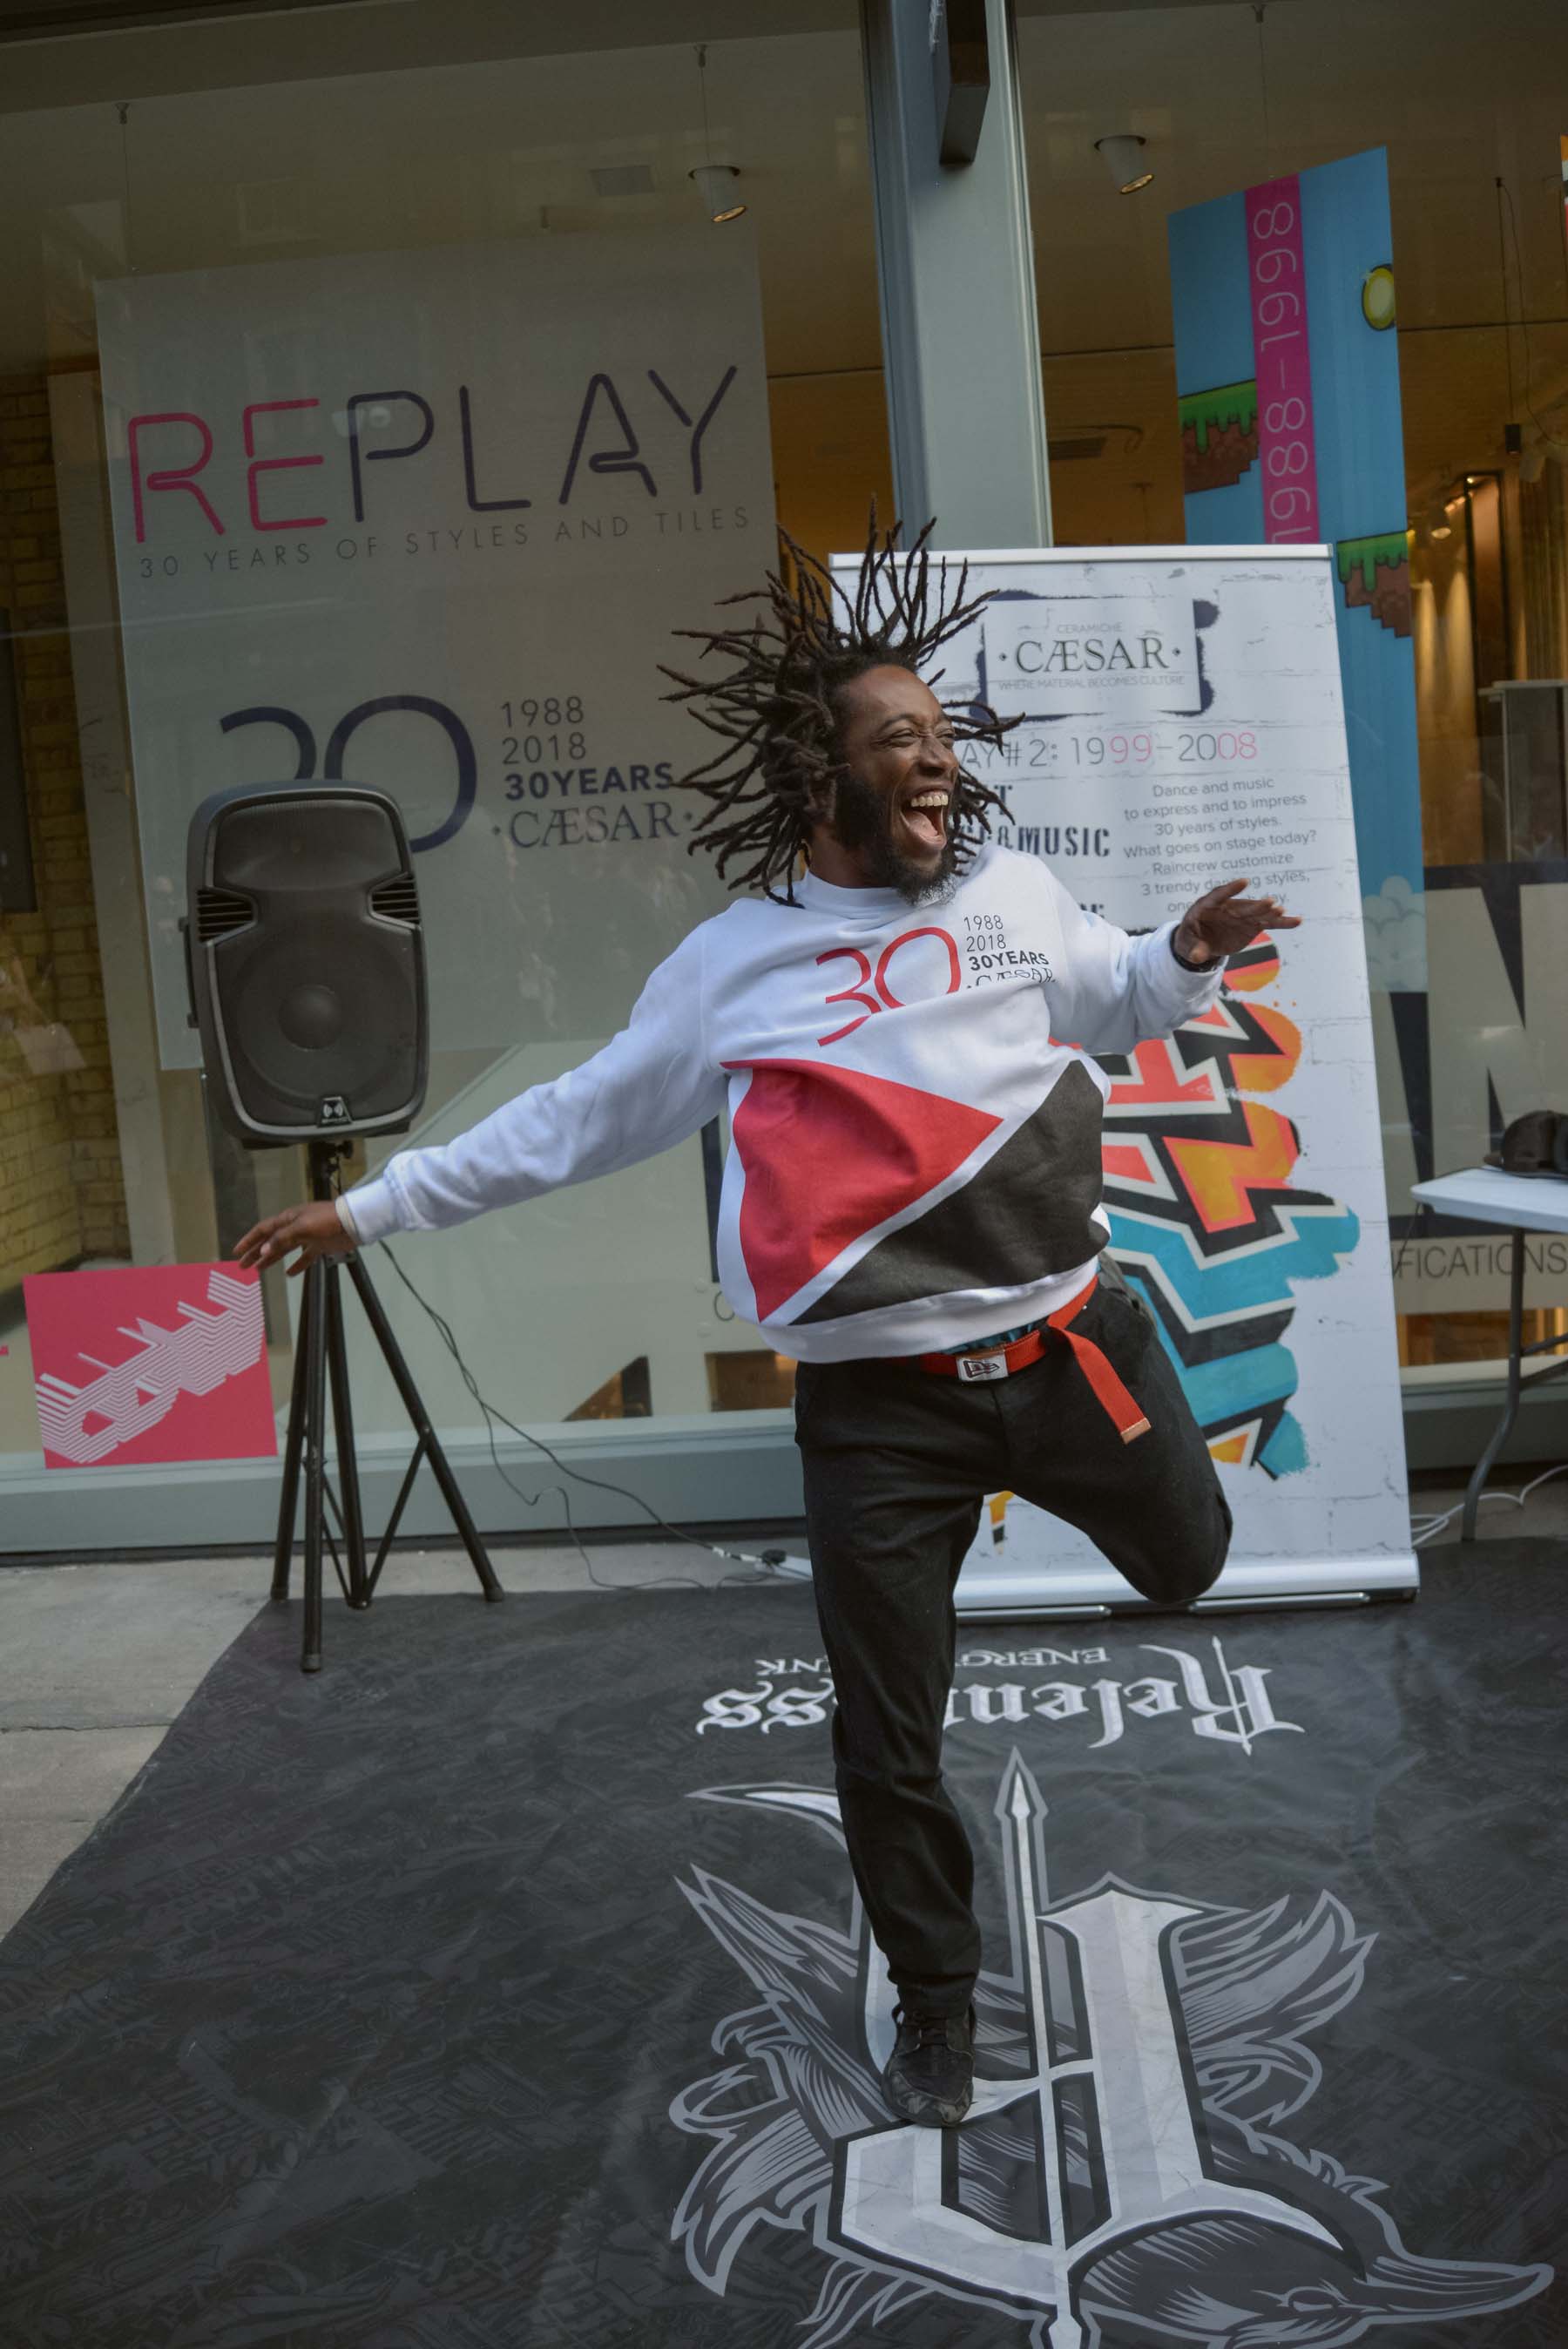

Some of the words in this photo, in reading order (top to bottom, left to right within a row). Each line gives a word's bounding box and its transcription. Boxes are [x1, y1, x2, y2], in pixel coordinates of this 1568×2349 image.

[128, 364, 738, 544] REPLAY
[140, 555, 179, 578] 30
[204, 542, 310, 572] YEARS
[336, 536, 377, 560] OF
[406, 524, 528, 553] STYLES
[555, 515, 628, 542] AND
[655, 506, 749, 533] TILES
[1056, 622, 1124, 634] CERAMICHE
[998, 680, 1036, 690] WHERE
[1037, 678, 1086, 688] MATERIAL
[1088, 676, 1139, 687] BECOMES
[1139, 675, 1186, 686] CULTURE
[502, 695, 585, 728] 1988
[502, 732, 586, 765] 2018
[504, 762, 674, 801] 30YEARS
[1152, 784, 1199, 797] Dance
[1202, 781, 1229, 795] and
[1233, 777, 1274, 791] music
[1125, 809, 1139, 821] to
[1143, 804, 1199, 819] express
[1202, 799, 1229, 813] and
[1233, 797, 1247, 810] to
[1251, 794, 1307, 810] impress
[1155, 822, 1174, 836] 30
[1178, 821, 1216, 837] years
[1220, 818, 1233, 831] of
[1237, 815, 1283, 830] styles.
[1123, 843, 1161, 859] What
[1166, 841, 1200, 857] goes
[1204, 839, 1222, 852] on
[1226, 836, 1265, 852] stage
[1268, 829, 1318, 846] today?
[1152, 858, 1218, 875] Raincrew
[1221, 851, 1294, 870] customize
[1141, 883, 1151, 897] 3
[1154, 879, 1201, 897] trendy
[1265, 870, 1311, 887] styles,
[963, 914, 1004, 931] 1988
[966, 933, 1007, 952] 2018
[968, 950, 1050, 971] 30YEARS
[815, 926, 962, 1046] 30
[1391, 1242, 1568, 1280] FICATIONS
[955, 1646, 1112, 1667] ENERG
